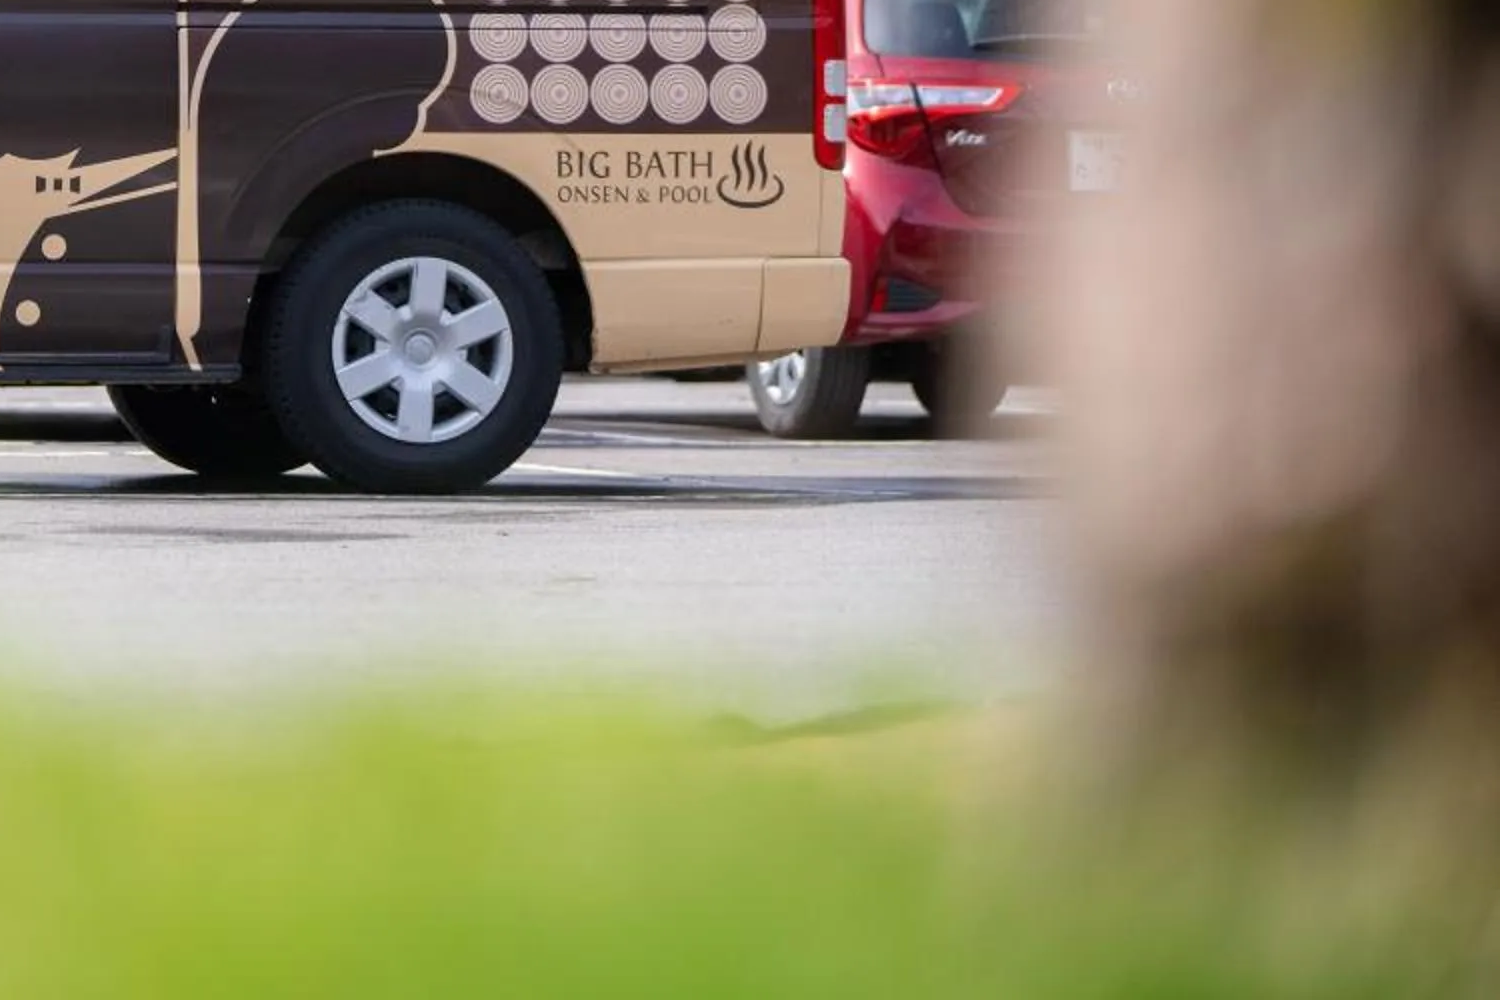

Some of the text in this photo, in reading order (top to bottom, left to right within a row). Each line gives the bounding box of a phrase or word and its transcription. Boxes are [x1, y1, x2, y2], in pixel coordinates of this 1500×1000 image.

[557, 151, 713, 179] BIG BATH
[557, 185, 714, 205] ONSEN & POOL
